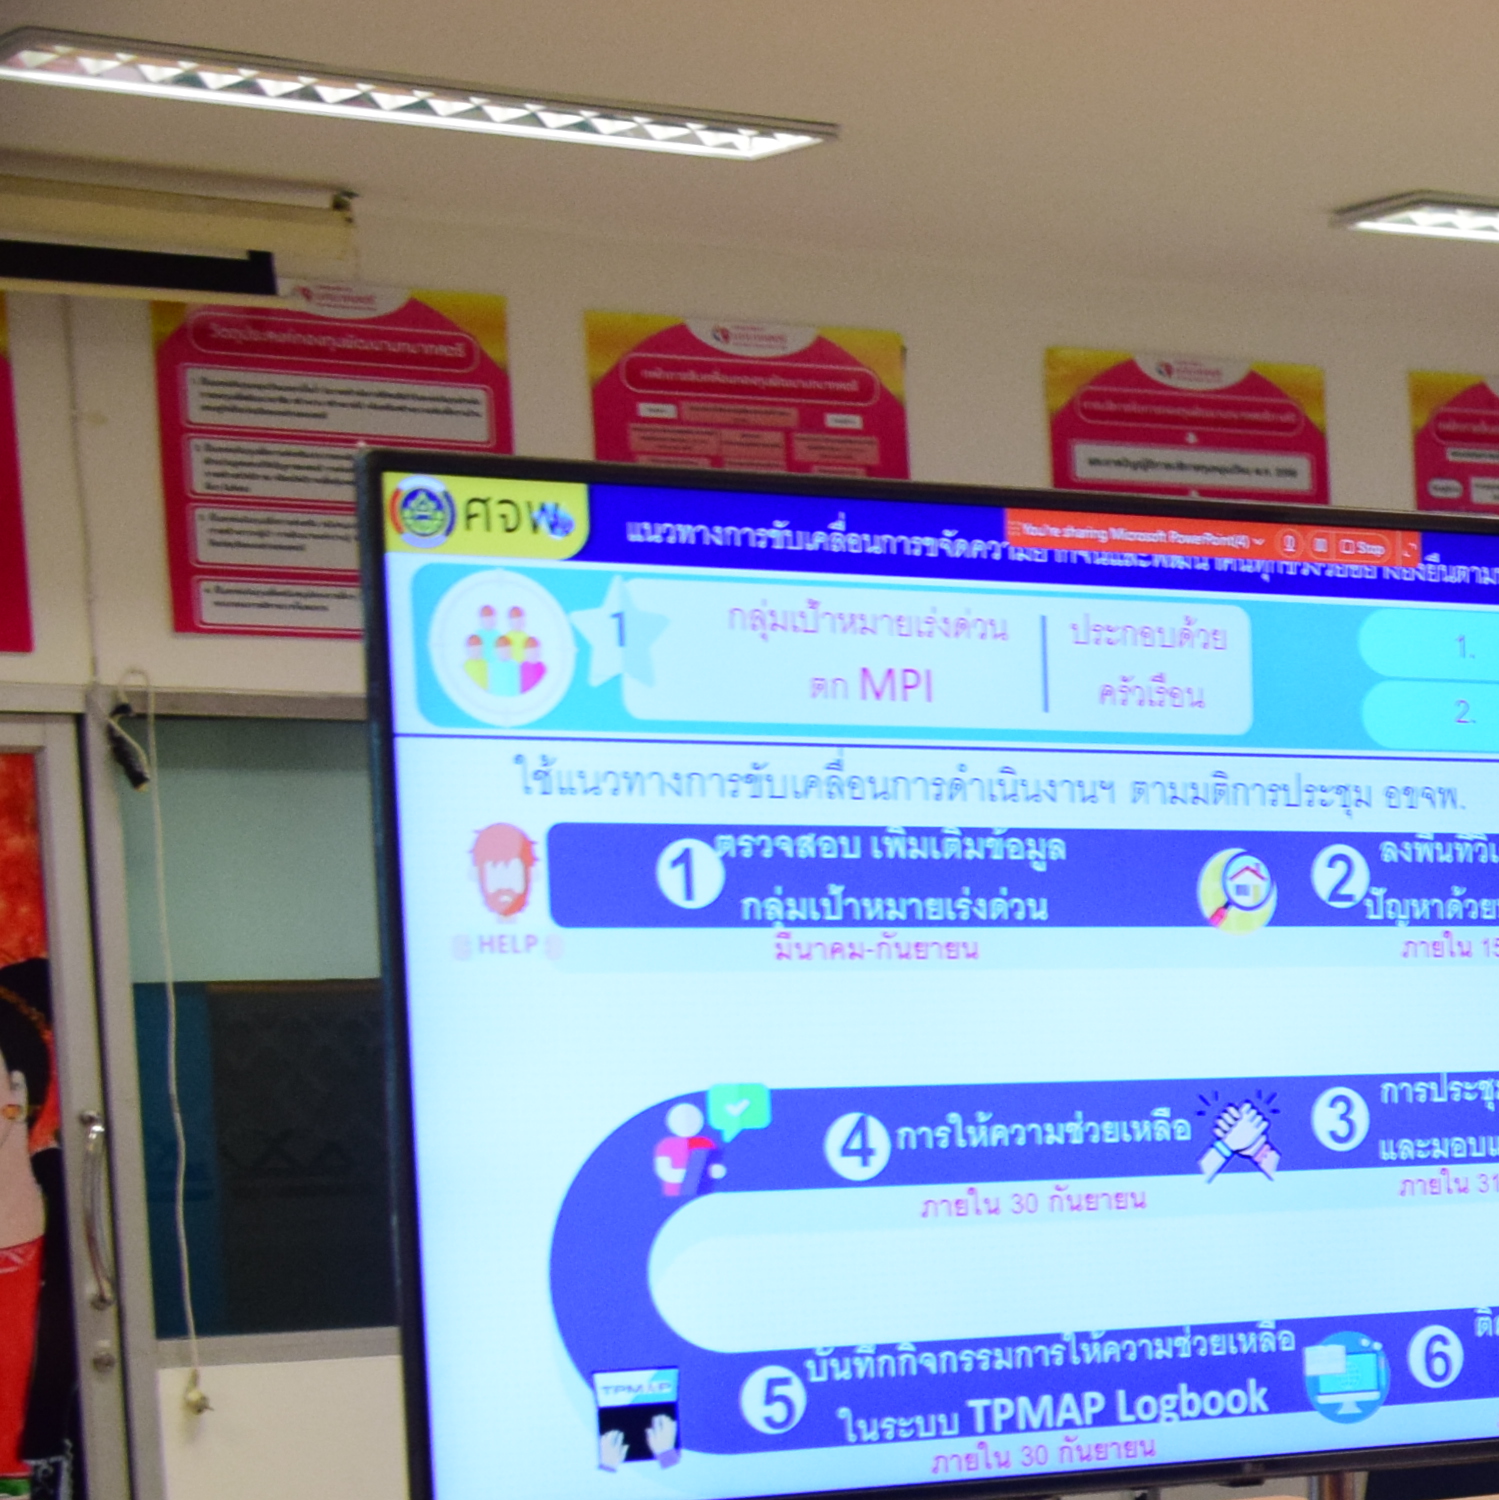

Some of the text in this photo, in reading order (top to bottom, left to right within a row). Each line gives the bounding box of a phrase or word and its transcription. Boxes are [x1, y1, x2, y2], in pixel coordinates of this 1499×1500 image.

[1062, 524, 1108, 543] sharing
[1109, 527, 1166, 545] Microsoft
[1356, 541, 1387, 557] Stop
[728, 599, 1009, 643] กลุ่มเป้าหมายเร่งด่วน
[1070, 613, 1228, 651] ประกอบด้วย
[860, 667, 933, 703] MPI
[1098, 672, 1206, 709] ครัวเรือน
[713, 826, 1067, 872] ตรวจสอบ เพิมเติมข้อมูล
[479, 933, 539, 954] HELP
[1401, 929, 1473, 960] ภายใน
[896, 1106, 1192, 1150] การให้ความช่วยเหลือ
[1399, 1167, 1469, 1197] ภายใน
[921, 1183, 1148, 1219] ภายใน 30 กันยายน
[836, 1378, 1269, 1442] ในระบบ TPMAP Logbook
[931, 1435, 1158, 1475] ภายใน 30 กันยายน
